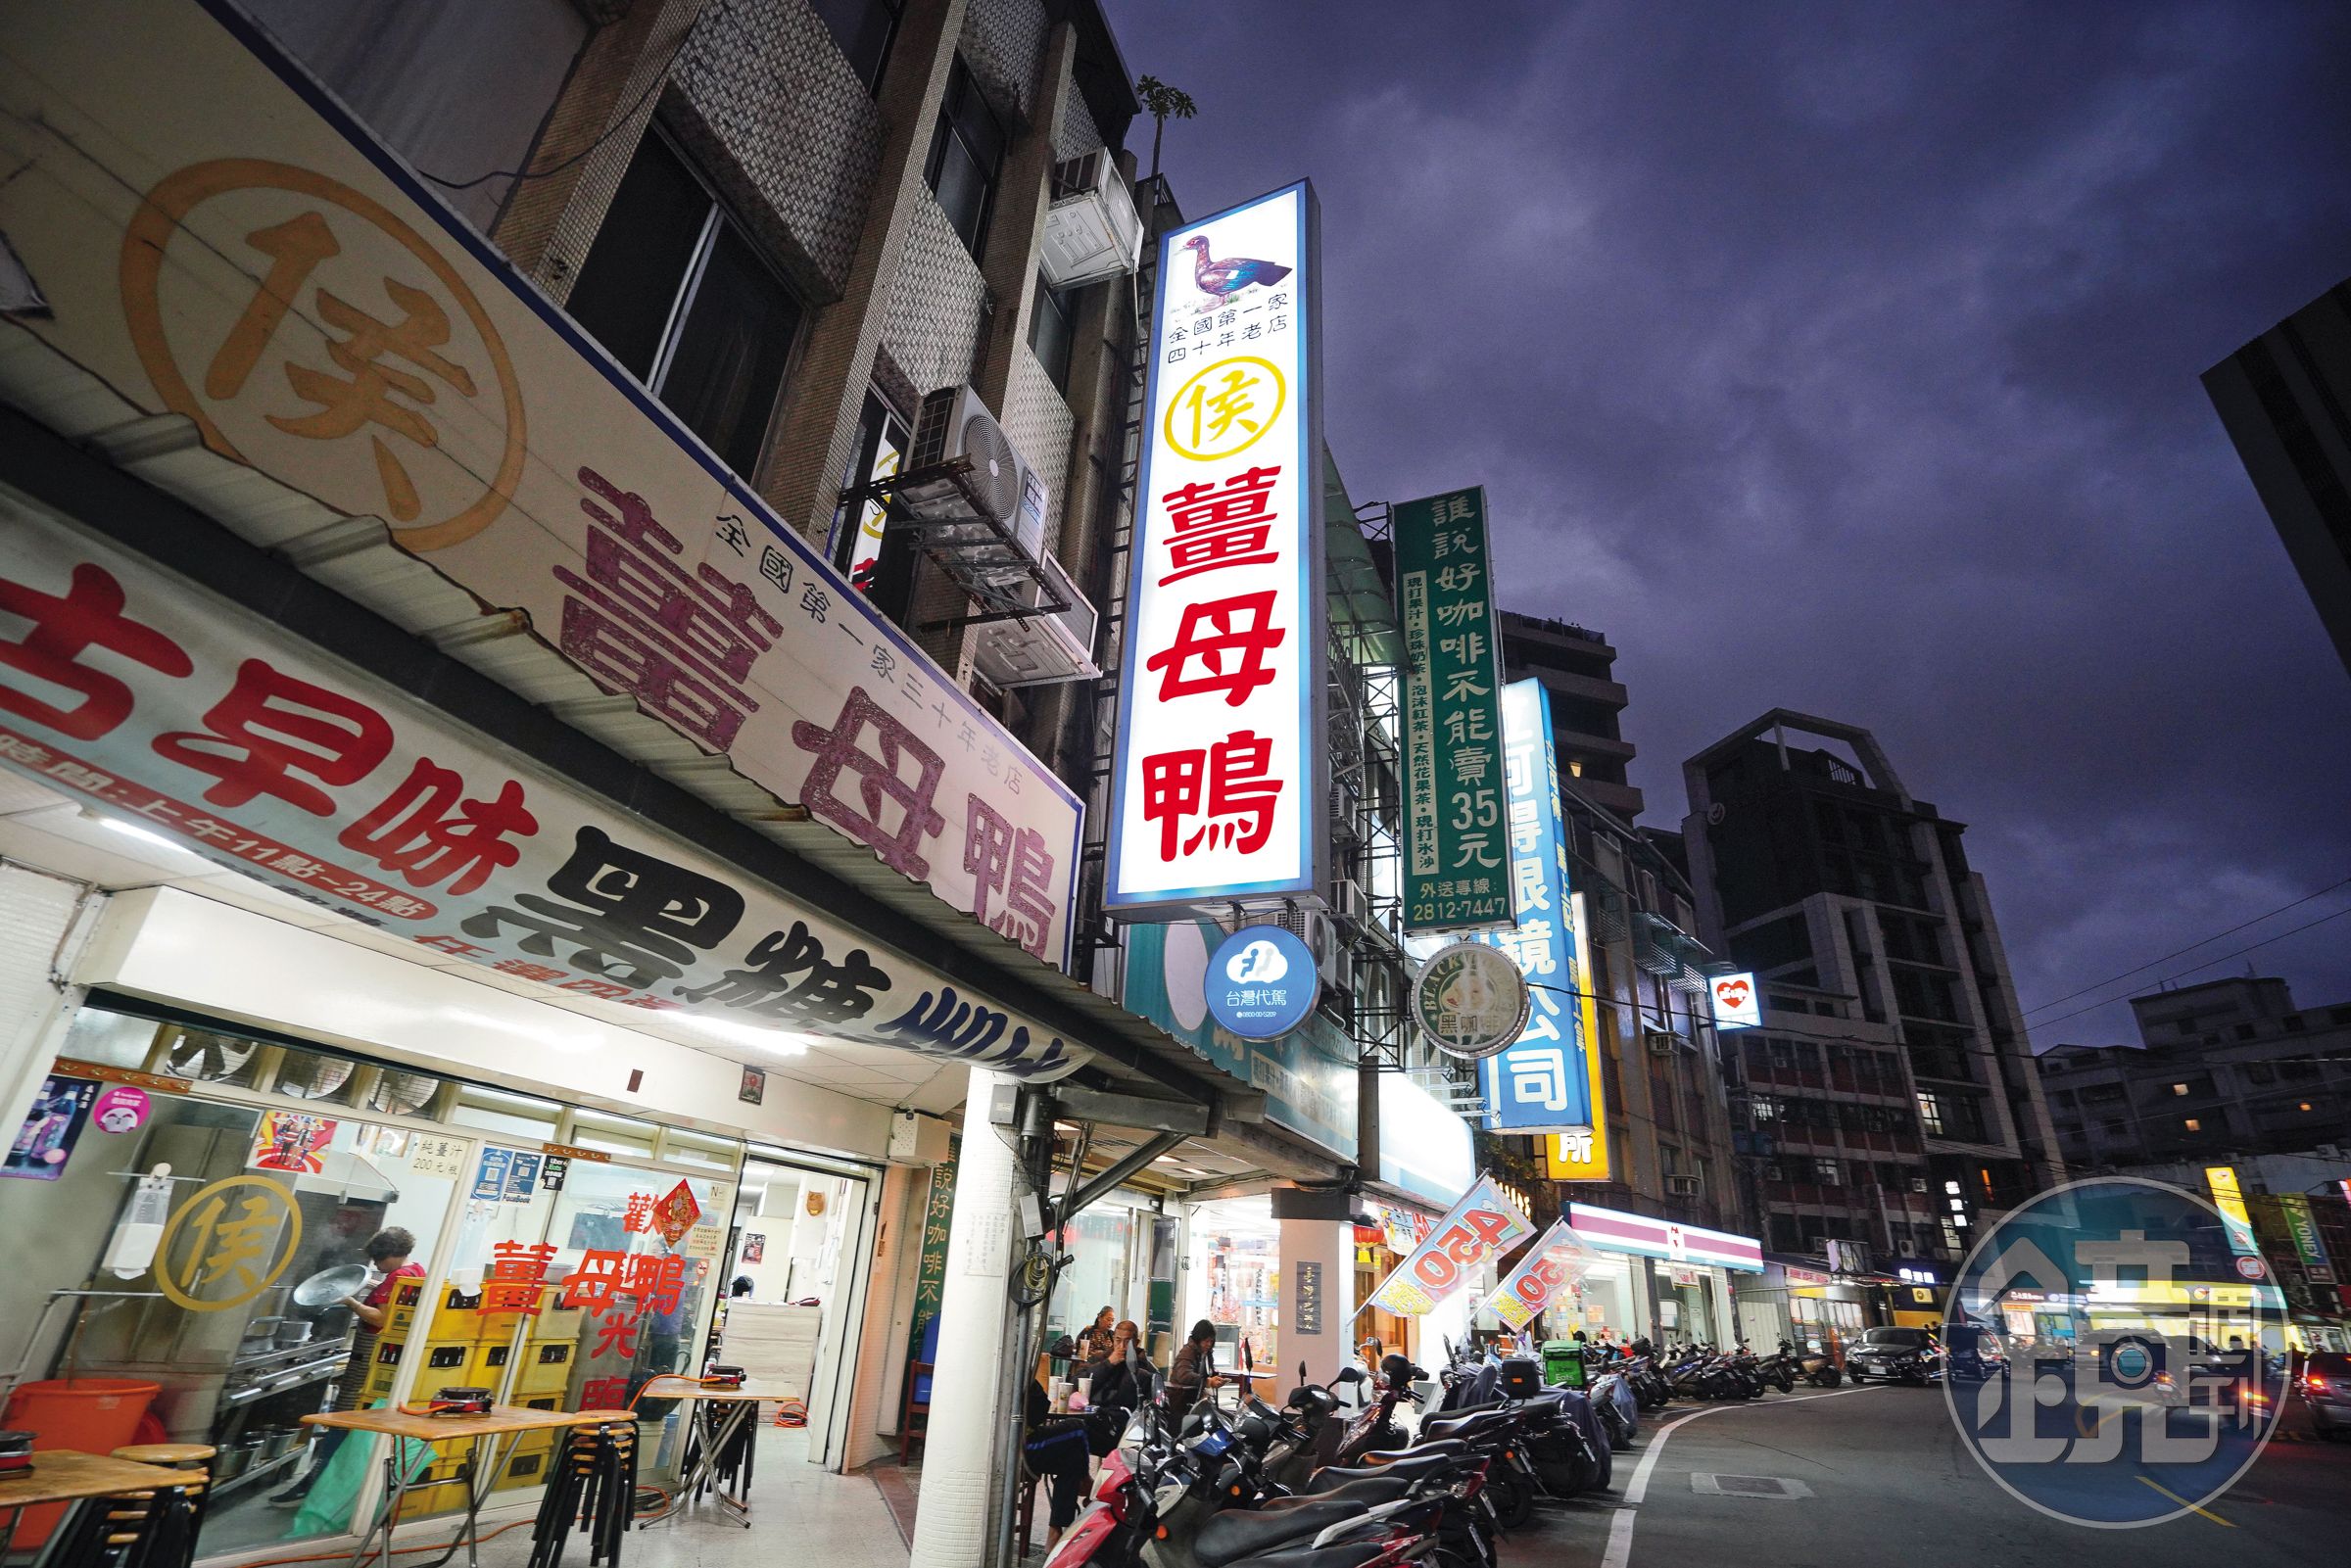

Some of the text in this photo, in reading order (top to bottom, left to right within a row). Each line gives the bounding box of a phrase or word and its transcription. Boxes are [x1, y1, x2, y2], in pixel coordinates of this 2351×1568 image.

[1168, 314, 1287, 364] 四十年老店
[1169, 293, 1288, 345] 全國第一家
[1185, 369, 1261, 450] 侯
[716, 514, 1024, 795] 全國第一家三十年老店
[1142, 465, 1285, 862] 薑母鴨
[552, 466, 1057, 962] 薑母鴨
[1226, 989, 1287, 1006] 台灣代駕
[1423, 955, 1462, 1011] BLACK
[421, 1140, 462, 1157] 純薑汁
[180, 1196, 279, 1288] 侯
[477, 1240, 686, 1317] 薑母鴨
